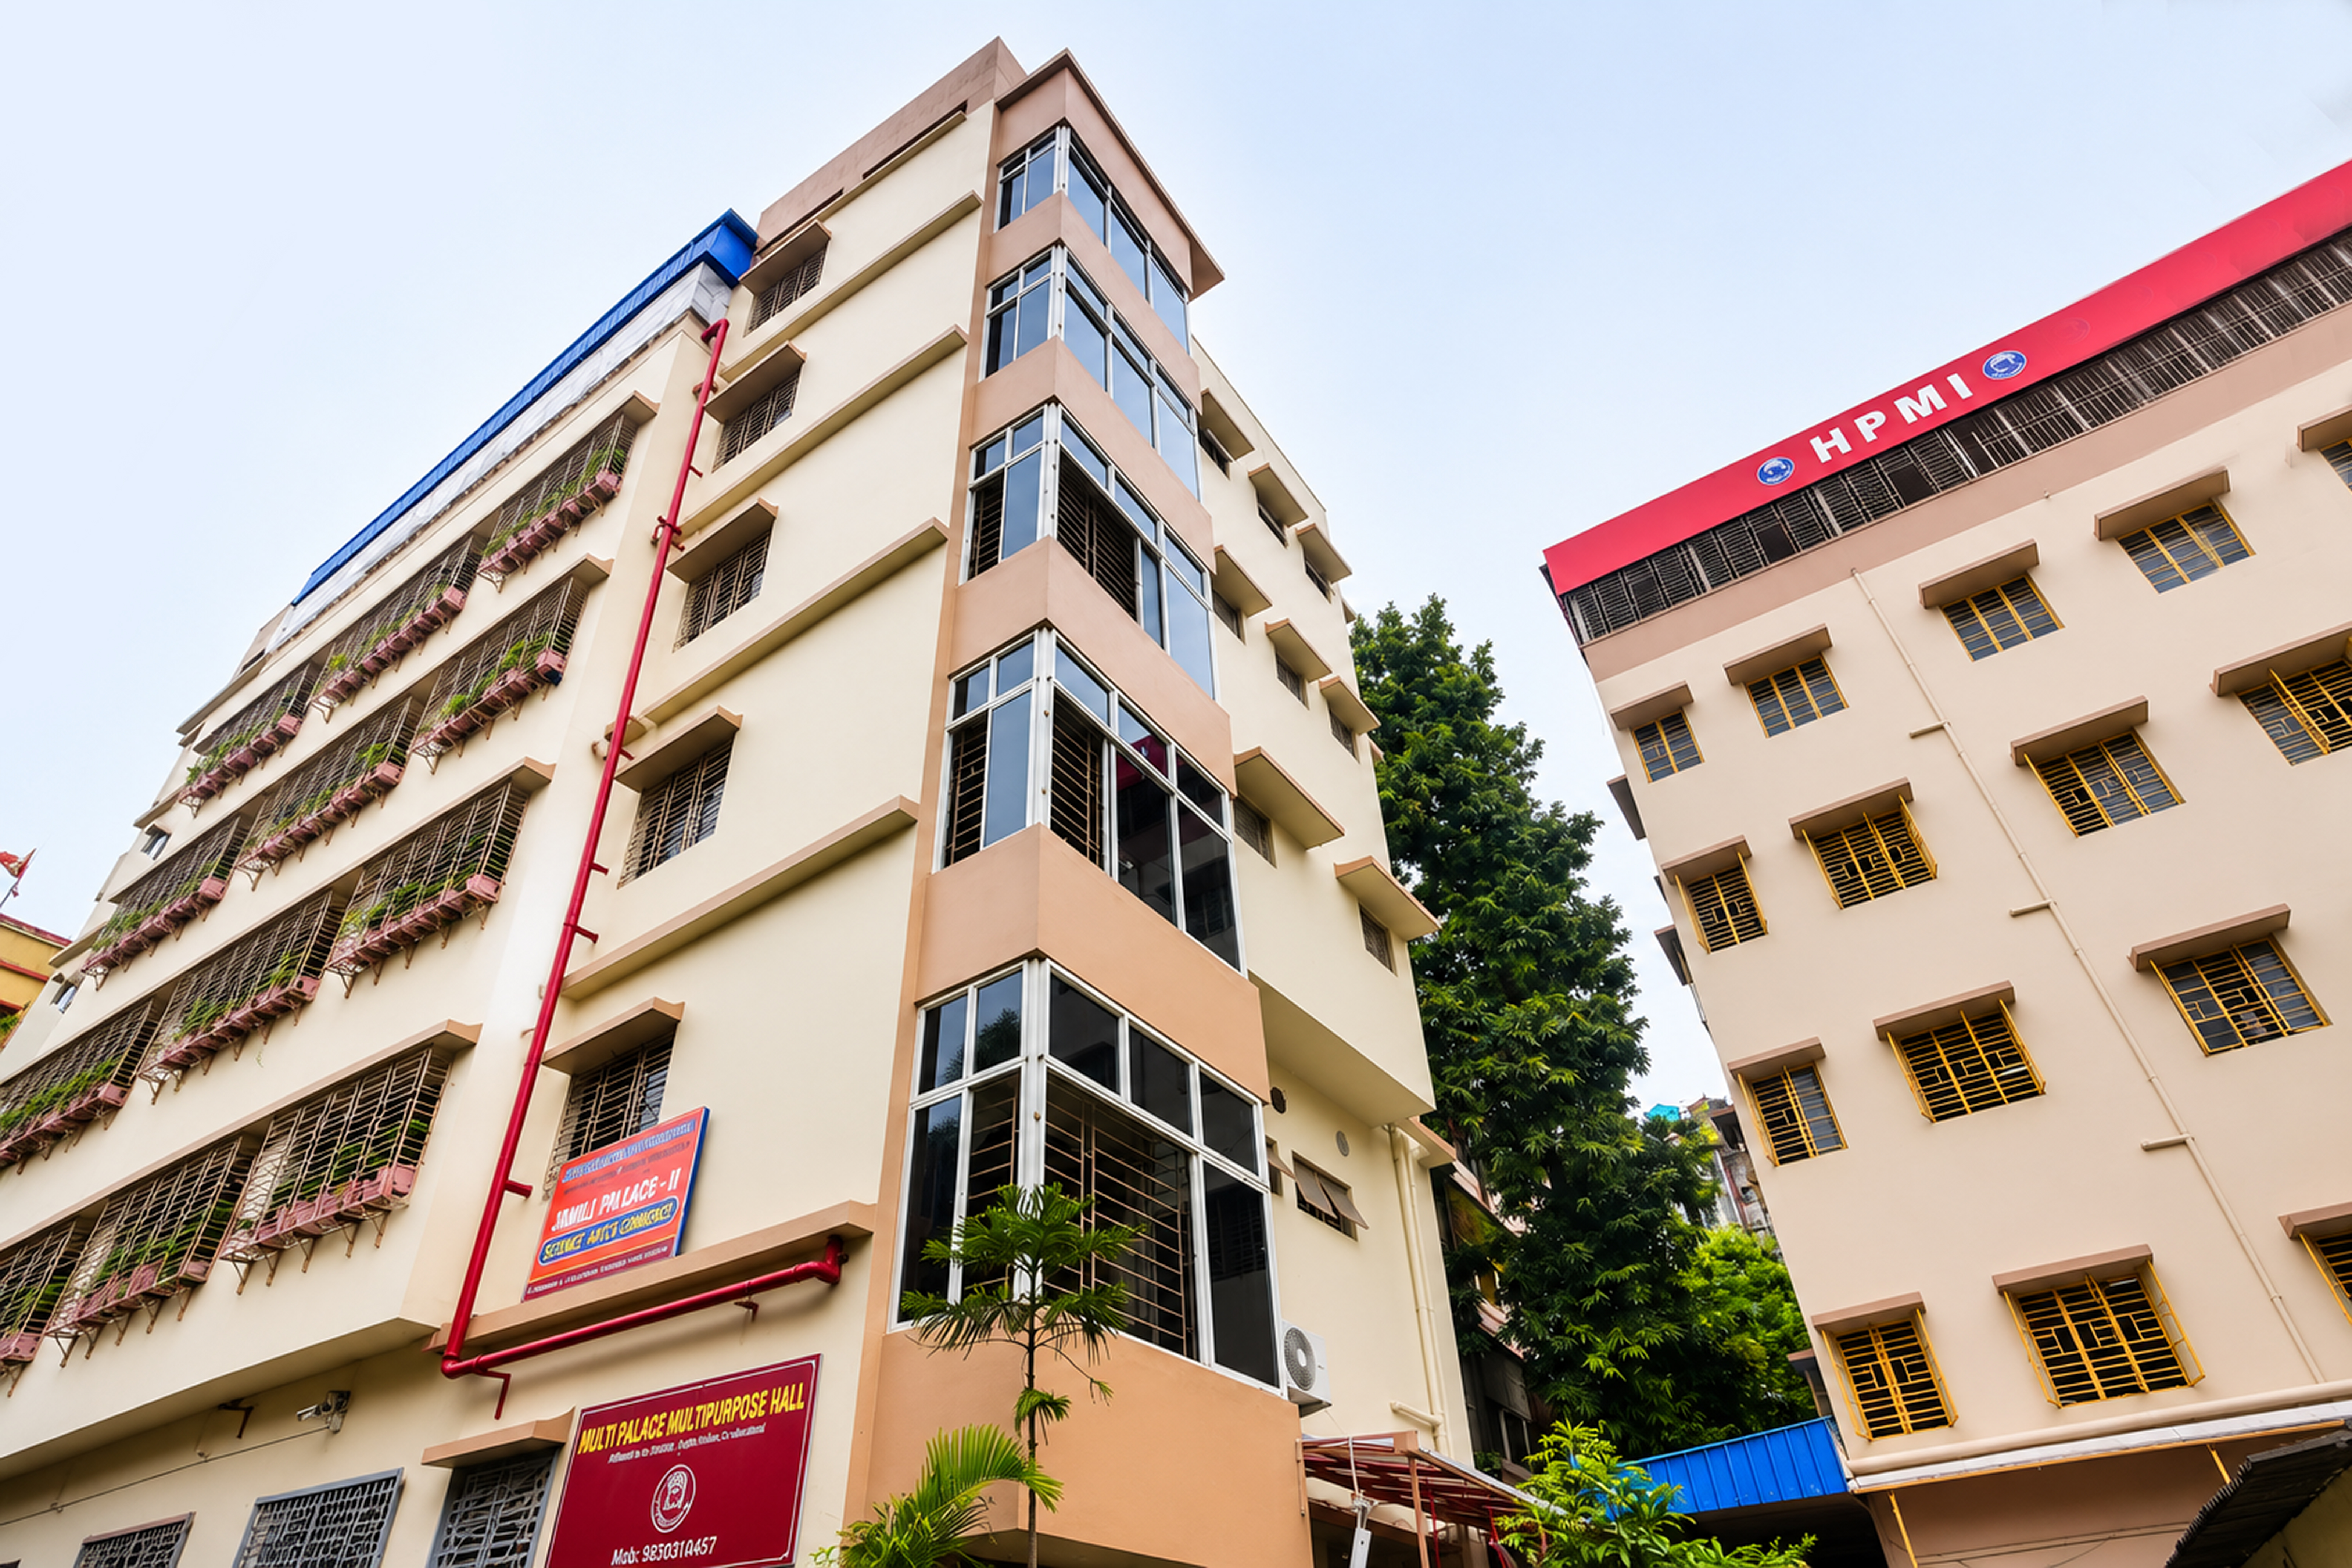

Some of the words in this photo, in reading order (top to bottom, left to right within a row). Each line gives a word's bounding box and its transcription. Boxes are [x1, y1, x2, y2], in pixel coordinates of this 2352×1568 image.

[1810, 373, 1973, 463] HPMI
[578, 1420, 617, 1454] MULTI
[616, 1412, 666, 1446] PALACE
[666, 1390, 768, 1436] MULTIPURPOSE
[770, 1382, 804, 1414] HALL
